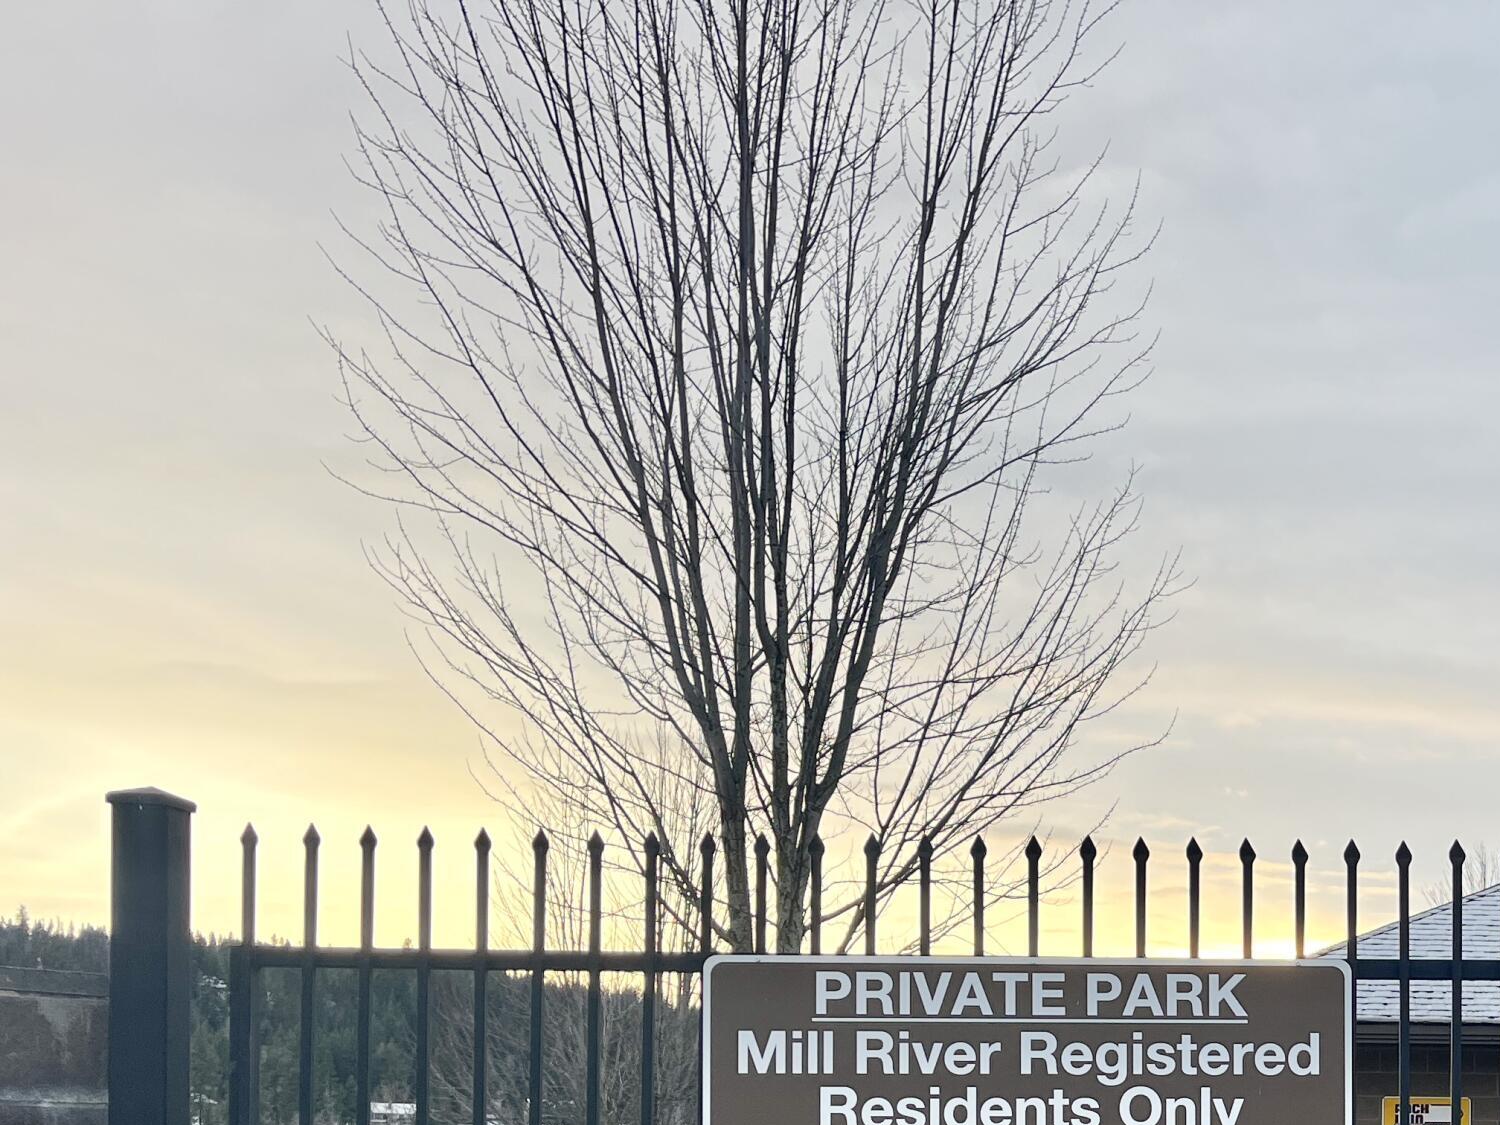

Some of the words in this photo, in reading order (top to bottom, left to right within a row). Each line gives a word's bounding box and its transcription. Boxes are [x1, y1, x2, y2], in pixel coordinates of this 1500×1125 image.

[816, 972, 1065, 1015] PRIVATE
[1087, 974, 1248, 1016] PARK
[738, 1031, 833, 1074] Mill
[857, 1031, 1001, 1075] River
[1021, 1032, 1319, 1085] Registered
